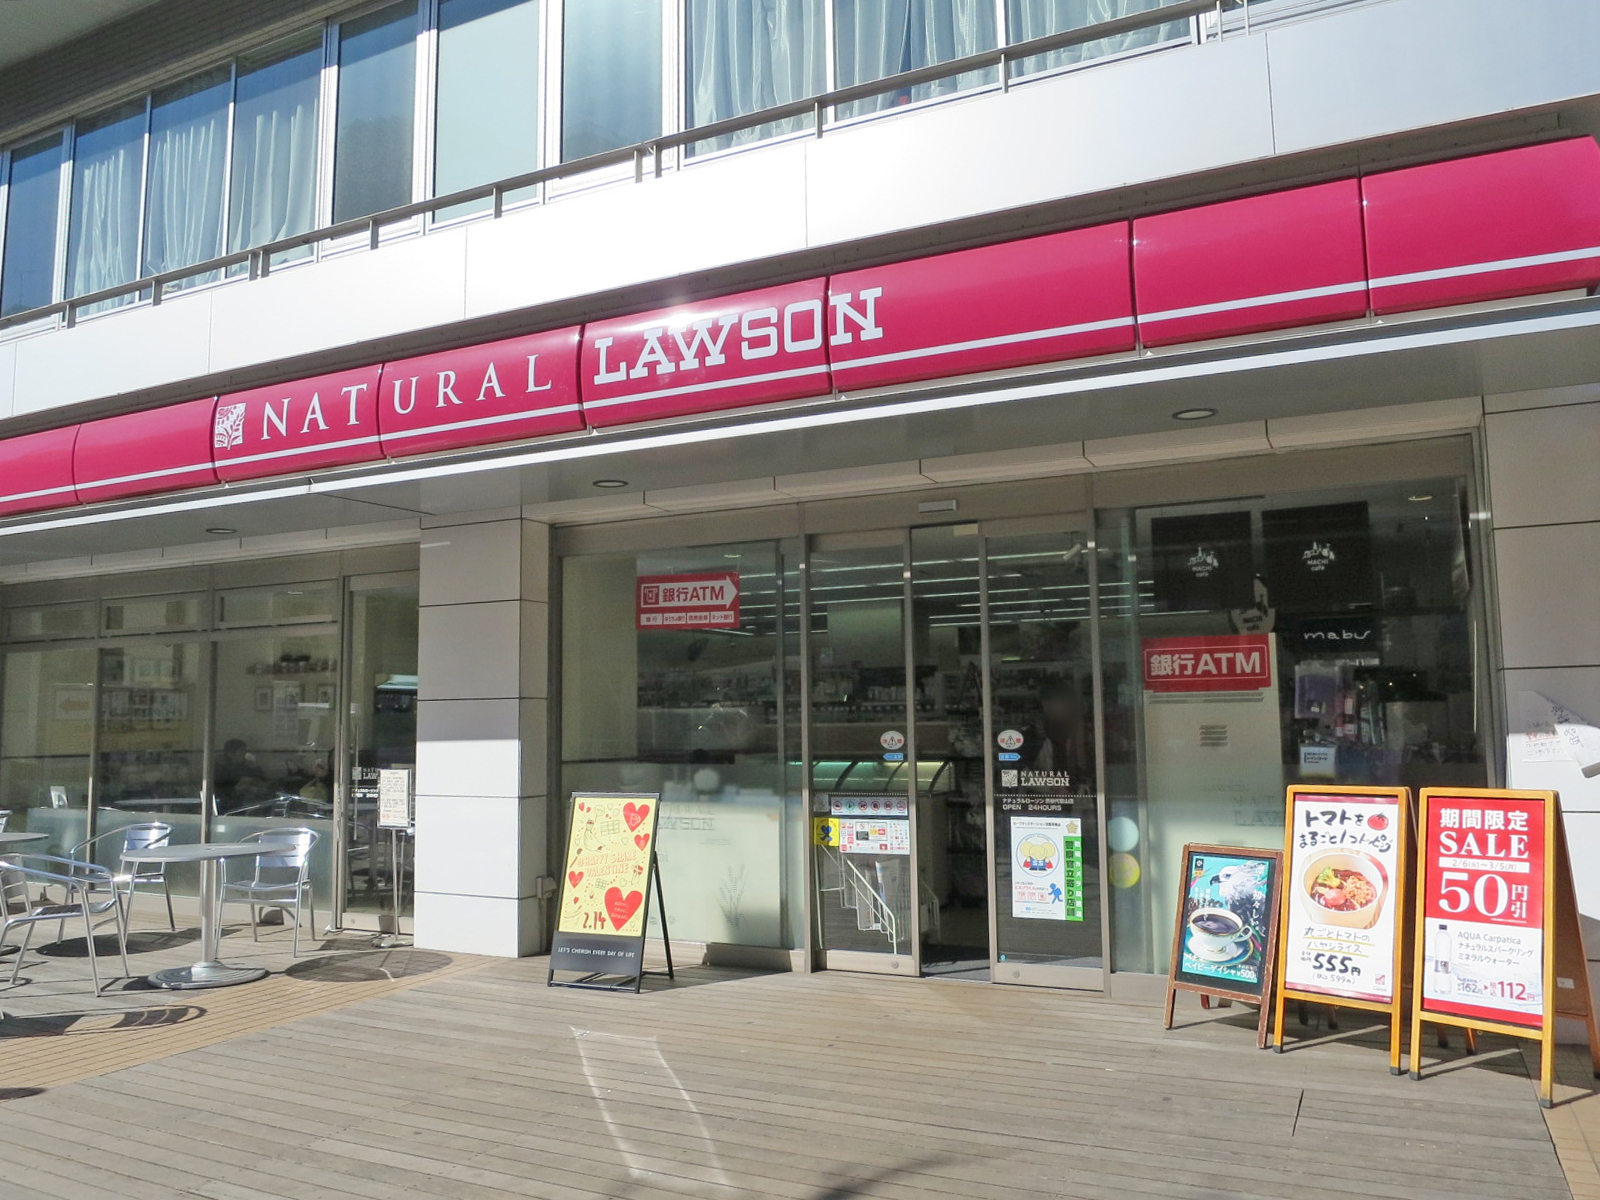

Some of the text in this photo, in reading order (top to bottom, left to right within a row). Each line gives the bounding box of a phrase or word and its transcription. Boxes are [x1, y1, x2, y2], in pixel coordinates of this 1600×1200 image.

[261, 286, 885, 440] NATURAL LAWSON
[662, 585, 725, 603] 銀行ATM
[1150, 652, 1261, 676] 銀行ATM
[1020, 770, 1070, 778] NATURAL
[1020, 777, 1070, 787] LAWSON
[1028, 804, 1062, 812] 24HOURS
[1305, 808, 1365, 828] トマトを
[1439, 808, 1529, 831] 期間限定
[1439, 830, 1530, 859] SALE
[582, 911, 606, 931] 2.14
[1303, 926, 1371, 942] 丸ごとトマトの
[1457, 931, 1522, 945] AQUA Carpatica
[557, 946, 571, 954] LET'S
[1306, 940, 1363, 954] ハヤシライス
[1457, 942, 1535, 957] ナチュラルスパークリング
[1312, 952, 1362, 976] 555円
[1458, 952, 1521, 966] ミネラルウォーター
